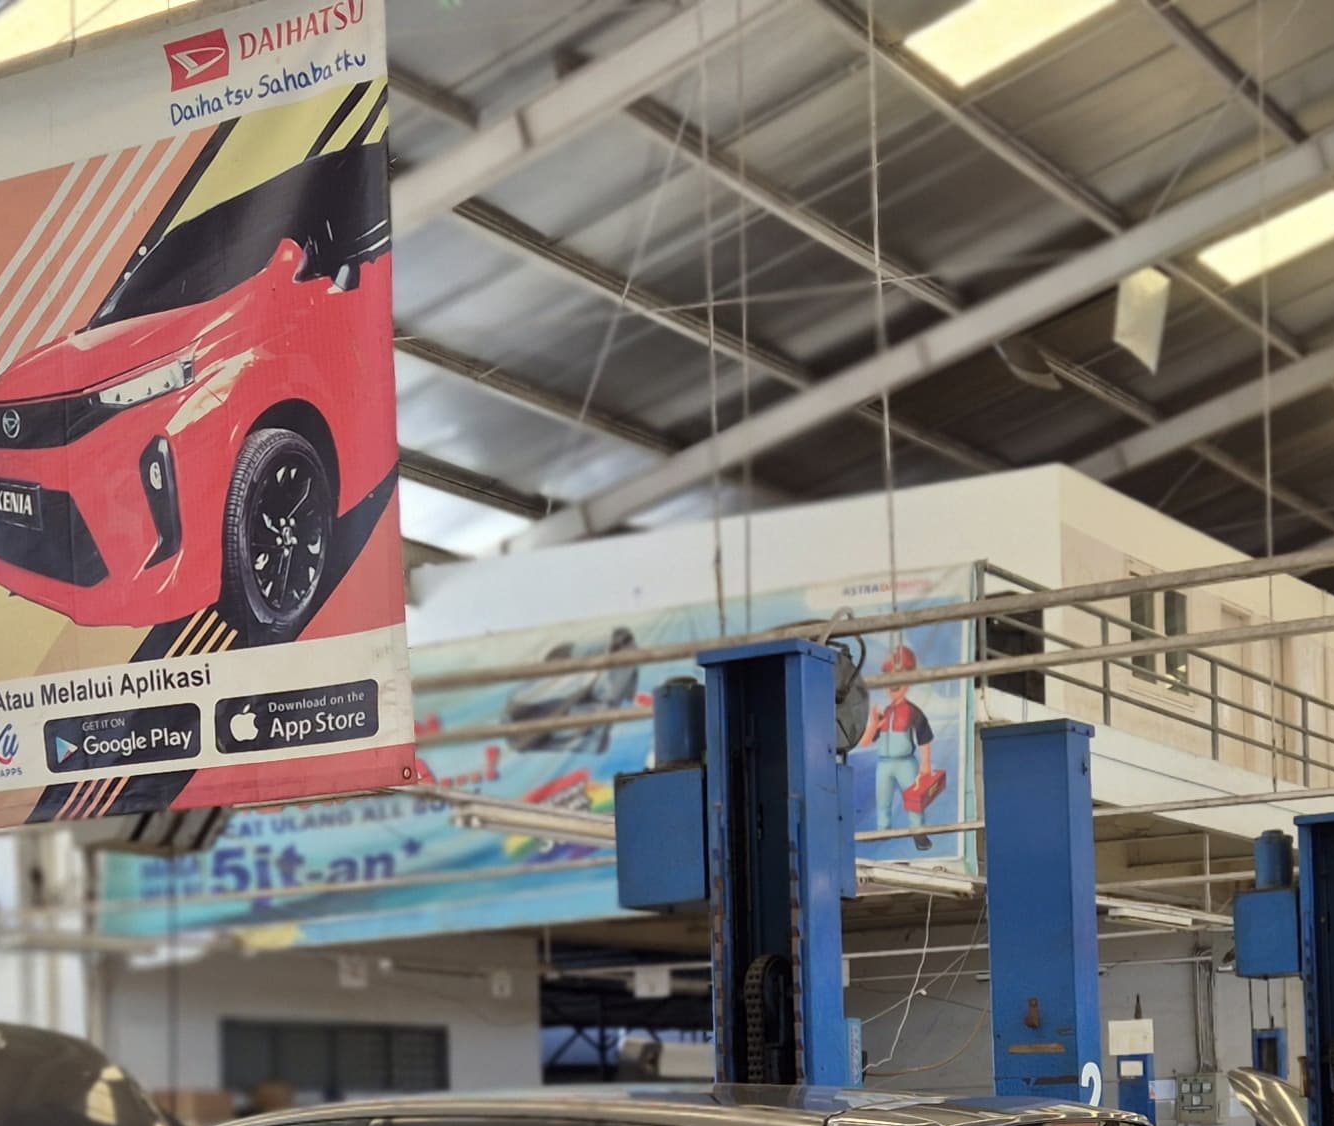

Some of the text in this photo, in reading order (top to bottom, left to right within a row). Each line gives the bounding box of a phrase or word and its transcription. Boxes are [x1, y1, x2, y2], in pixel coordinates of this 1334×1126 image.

[238, 0, 364, 60] DAIHATSU
[170, 87, 253, 126] Daihatsu
[40, 675, 113, 706] Melalui
[120, 663, 211, 699] Aplikasi
[268, 691, 364, 713] Download on the
[82, 720, 99, 732] GET
[110, 717, 126, 729] ON
[269, 711, 366, 742] App Store
[83, 728, 193, 757] Google Play
[0, 767, 23, 778] APPS
[1081, 1062, 1102, 1107] 2
